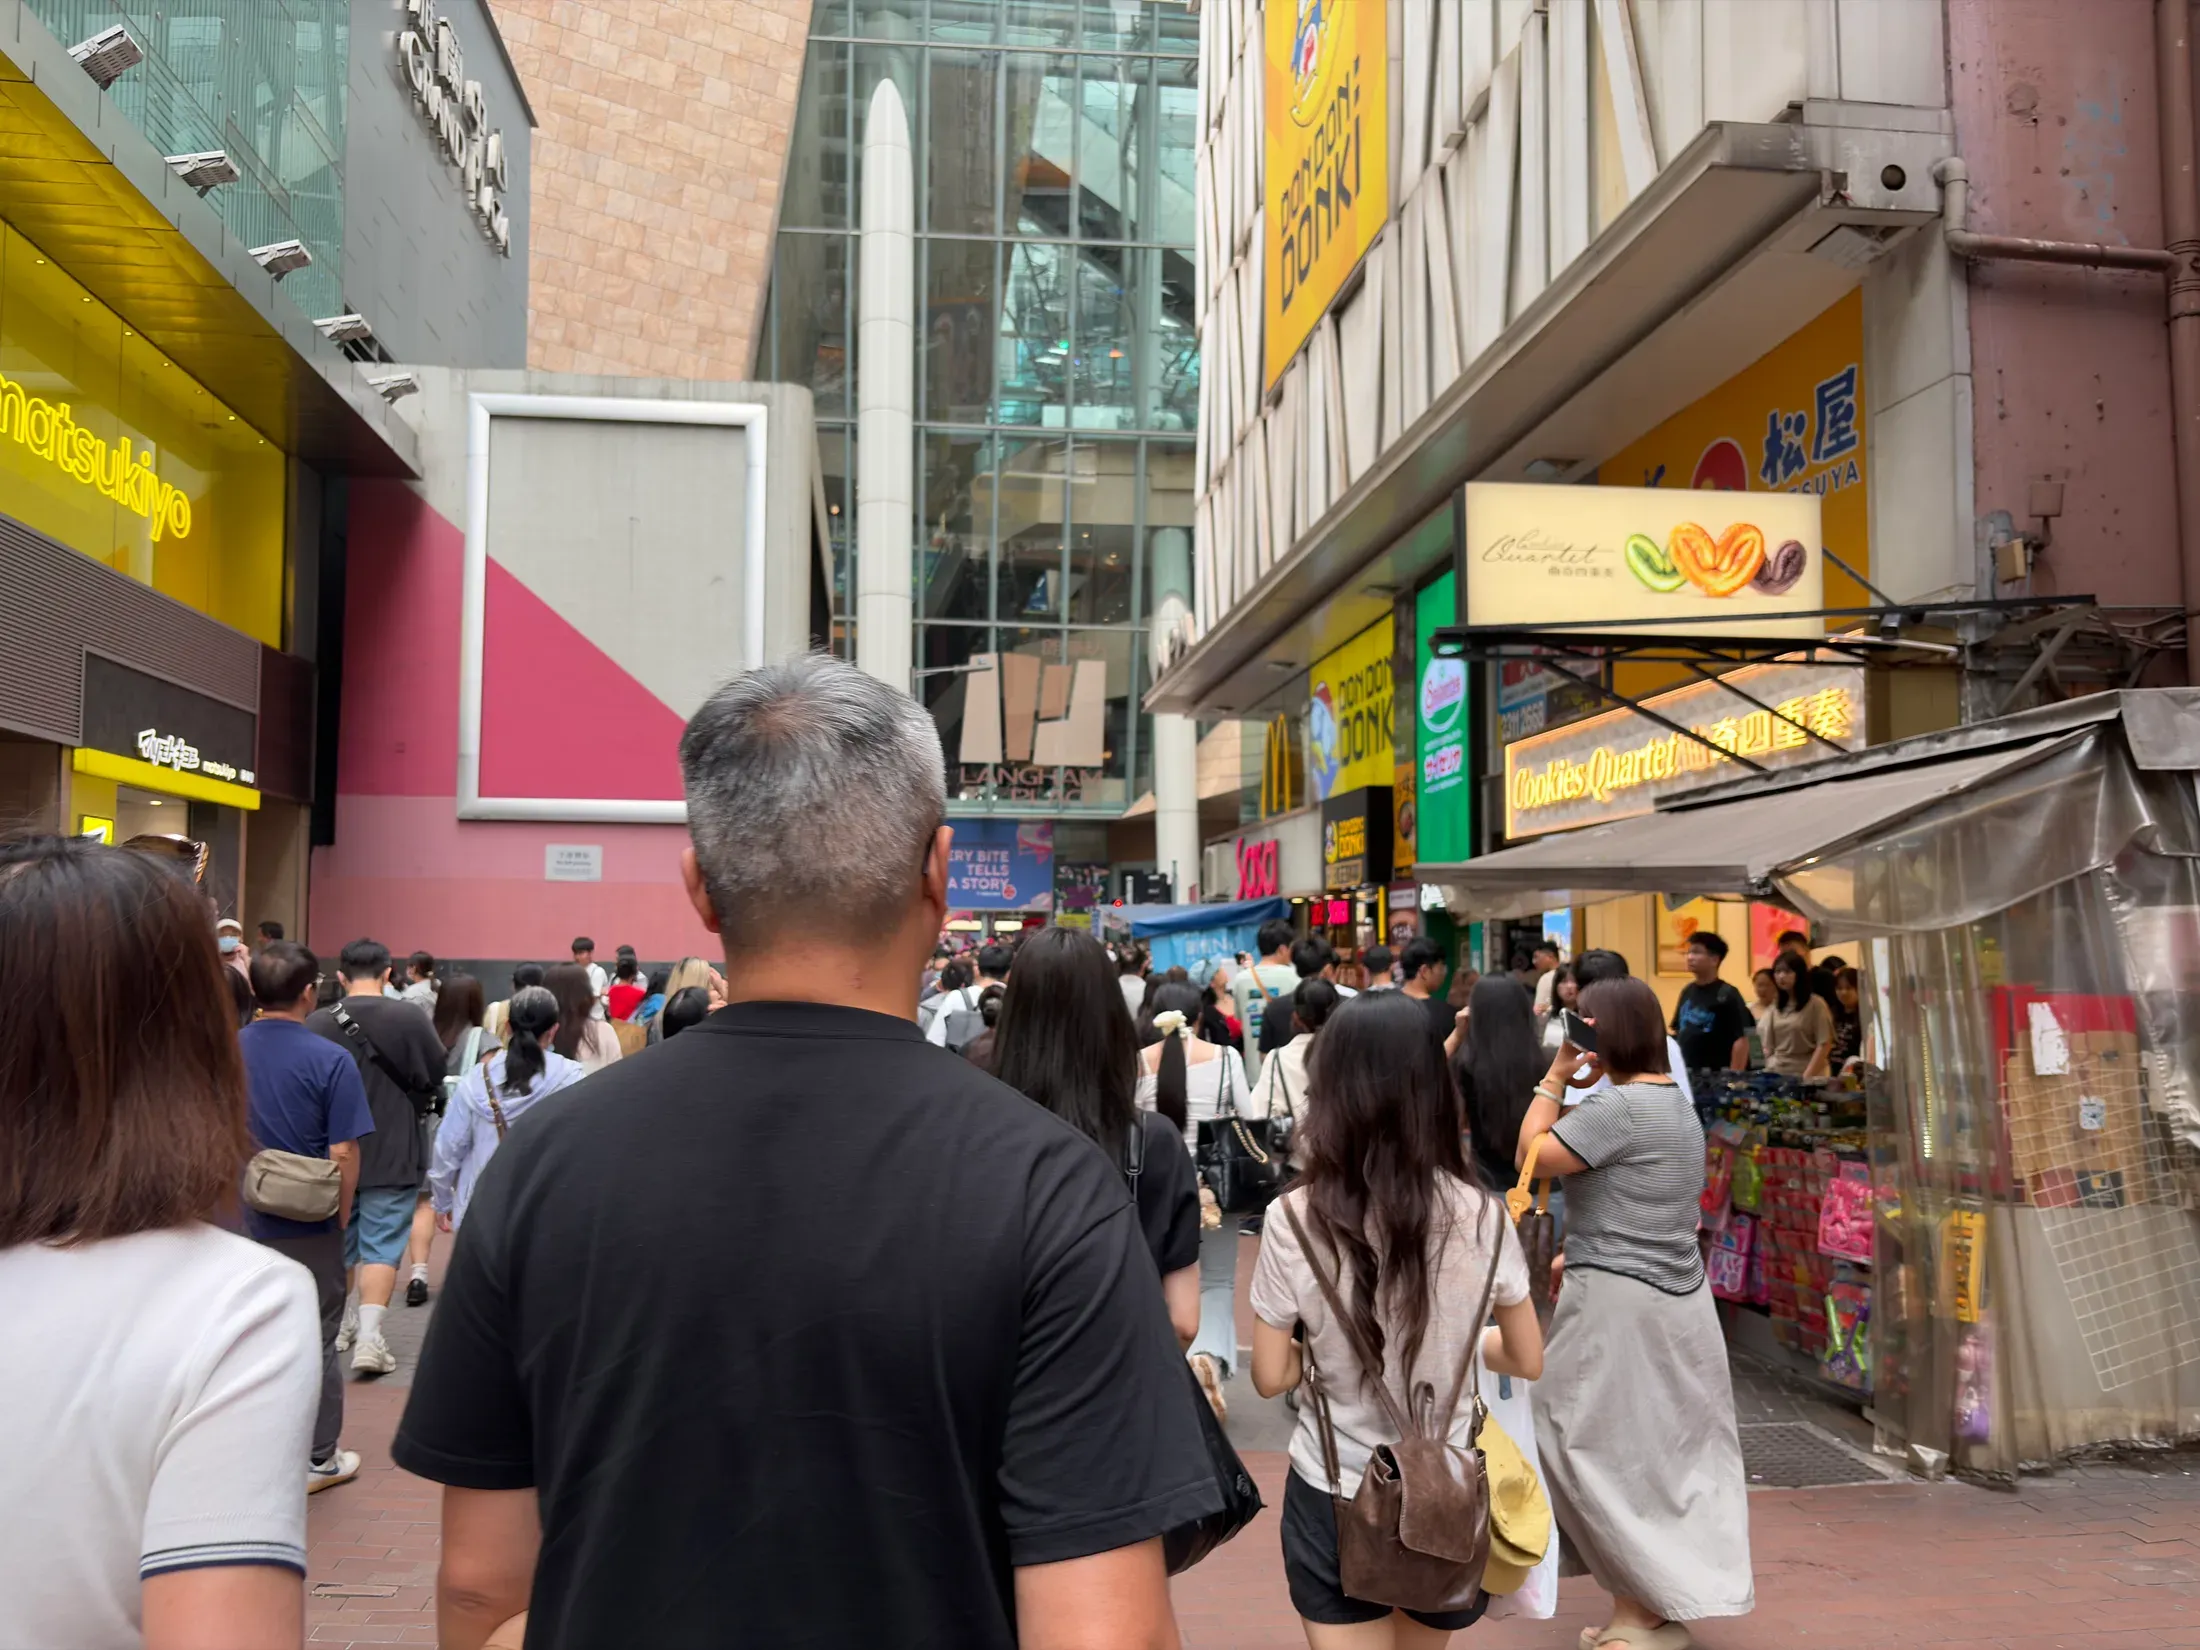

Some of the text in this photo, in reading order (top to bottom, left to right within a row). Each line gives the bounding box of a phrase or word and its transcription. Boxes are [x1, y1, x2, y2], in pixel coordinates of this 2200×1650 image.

[1281, 113, 1361, 316] DONKI
[1760, 363, 1858, 488] 松屋
[1482, 534, 1598, 564] Quartet
[960, 766, 1102, 785] LANGHAM
[1512, 731, 1679, 810] Cookies Quartet
[977, 850, 1009, 862] BITE
[966, 864, 1010, 876] TELLS
[947, 877, 1010, 890] A STORY
